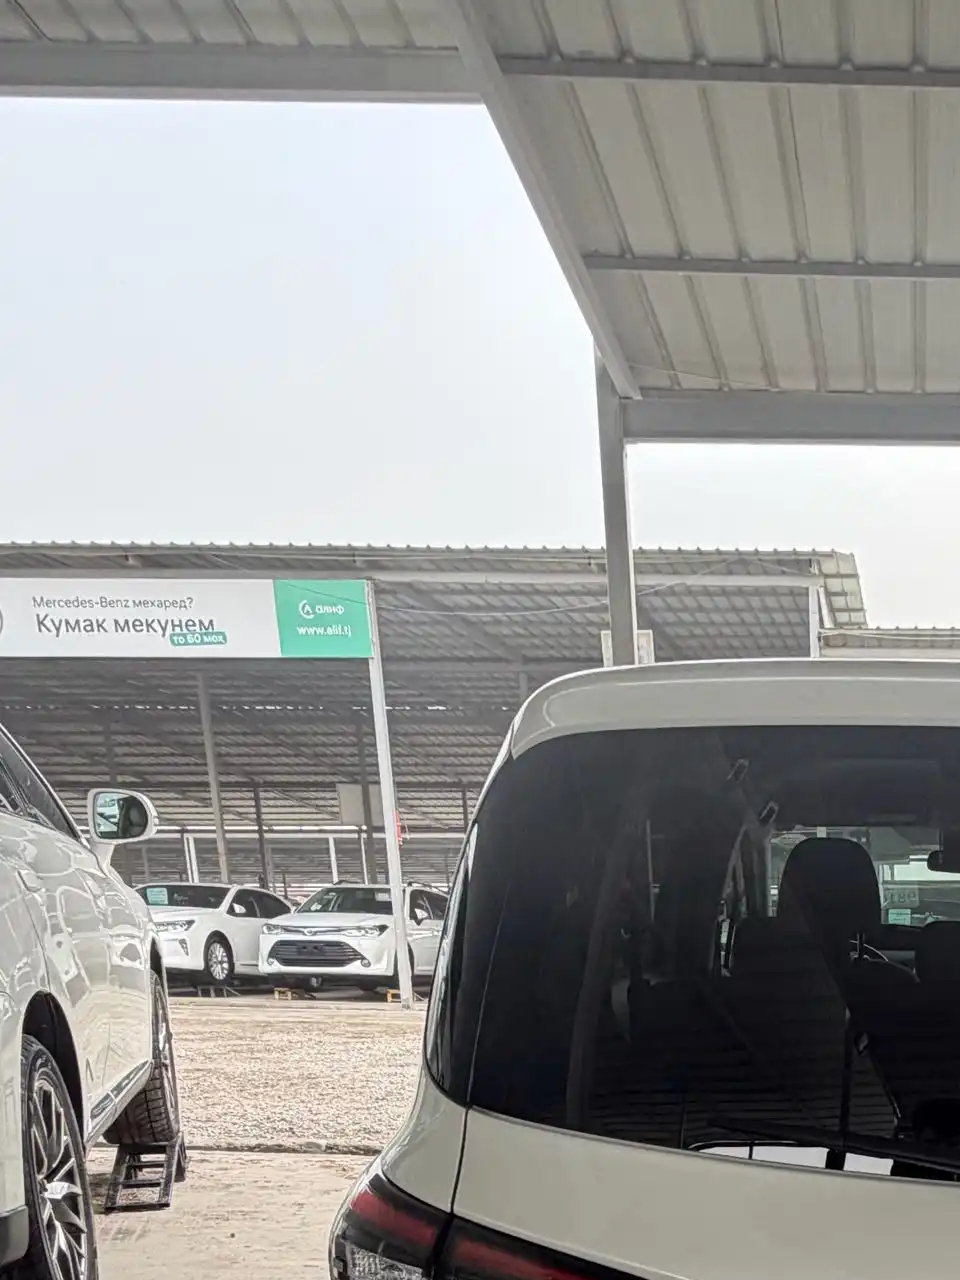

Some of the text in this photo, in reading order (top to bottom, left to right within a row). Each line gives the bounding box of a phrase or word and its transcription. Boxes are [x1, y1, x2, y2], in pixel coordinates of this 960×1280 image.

[32, 596, 194, 611] Mercedes-Benz мехаред?
[35, 613, 215, 638] Кумак мекунем
[187, 633, 201, 644] 60
